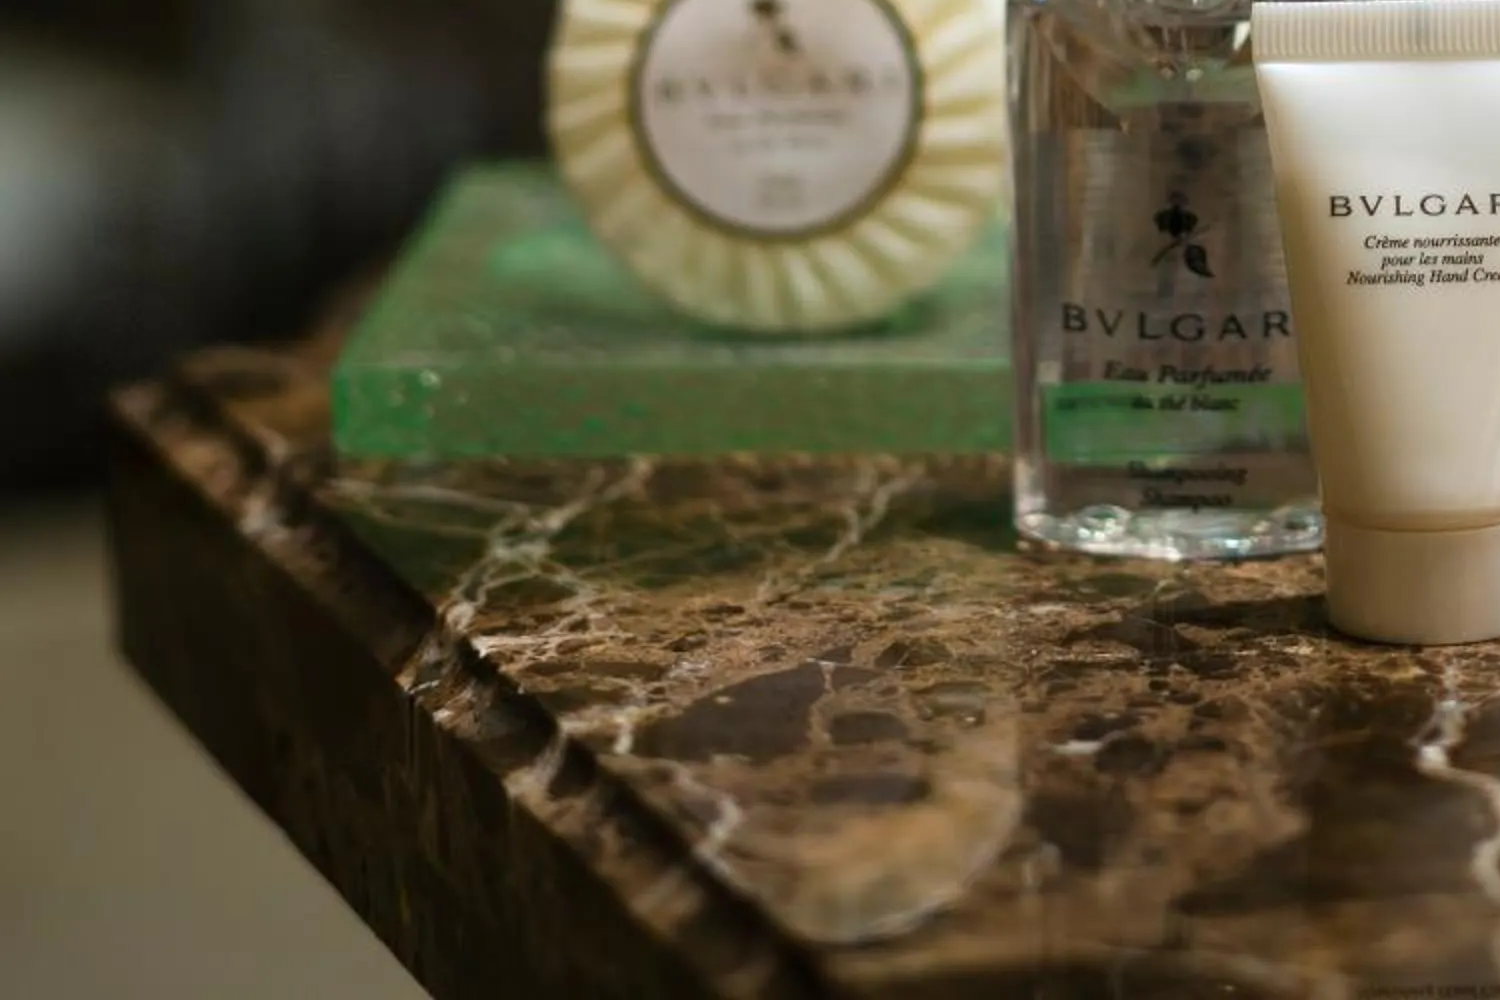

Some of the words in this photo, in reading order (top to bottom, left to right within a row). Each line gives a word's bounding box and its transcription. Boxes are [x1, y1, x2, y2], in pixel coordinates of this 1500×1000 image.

[1364, 234, 1408, 249] Crème
[1414, 234, 1500, 249] nourrissante
[1381, 253, 1414, 270] pour
[1419, 252, 1438, 265] les
[1442, 252, 1484, 265] mains
[1347, 270, 1425, 287] Nourishing
[1430, 269, 1468, 283] Hand
[1062, 303, 1291, 342] BVLGAR
